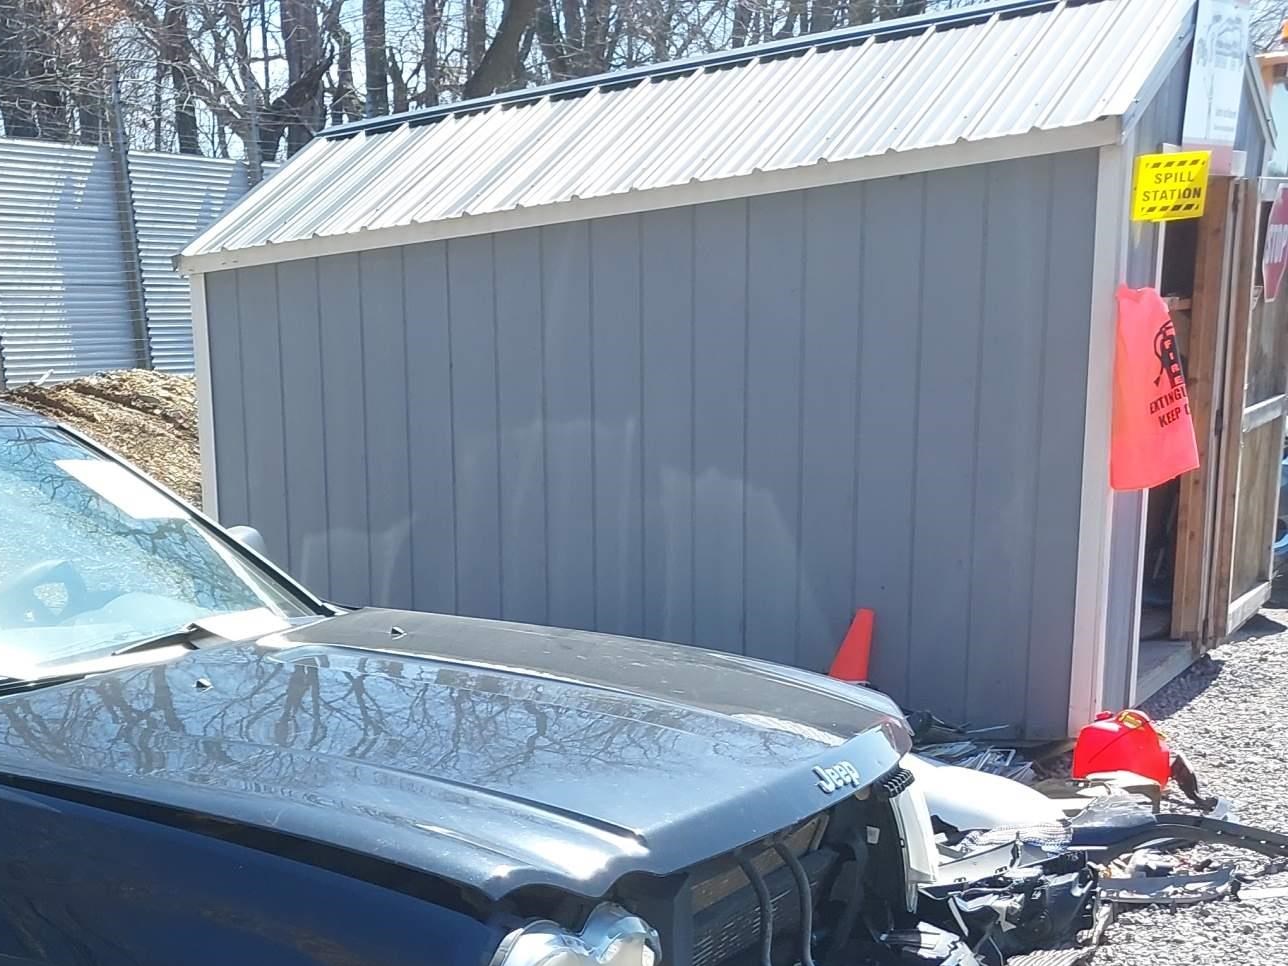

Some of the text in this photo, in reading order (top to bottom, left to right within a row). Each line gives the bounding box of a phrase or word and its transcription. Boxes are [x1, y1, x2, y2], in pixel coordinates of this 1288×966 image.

[1154, 171, 1194, 184] SPILL
[1142, 187, 1202, 202] STATION
[1158, 406, 1182, 428] KEEP
[811, 760, 861, 794] Jeep
